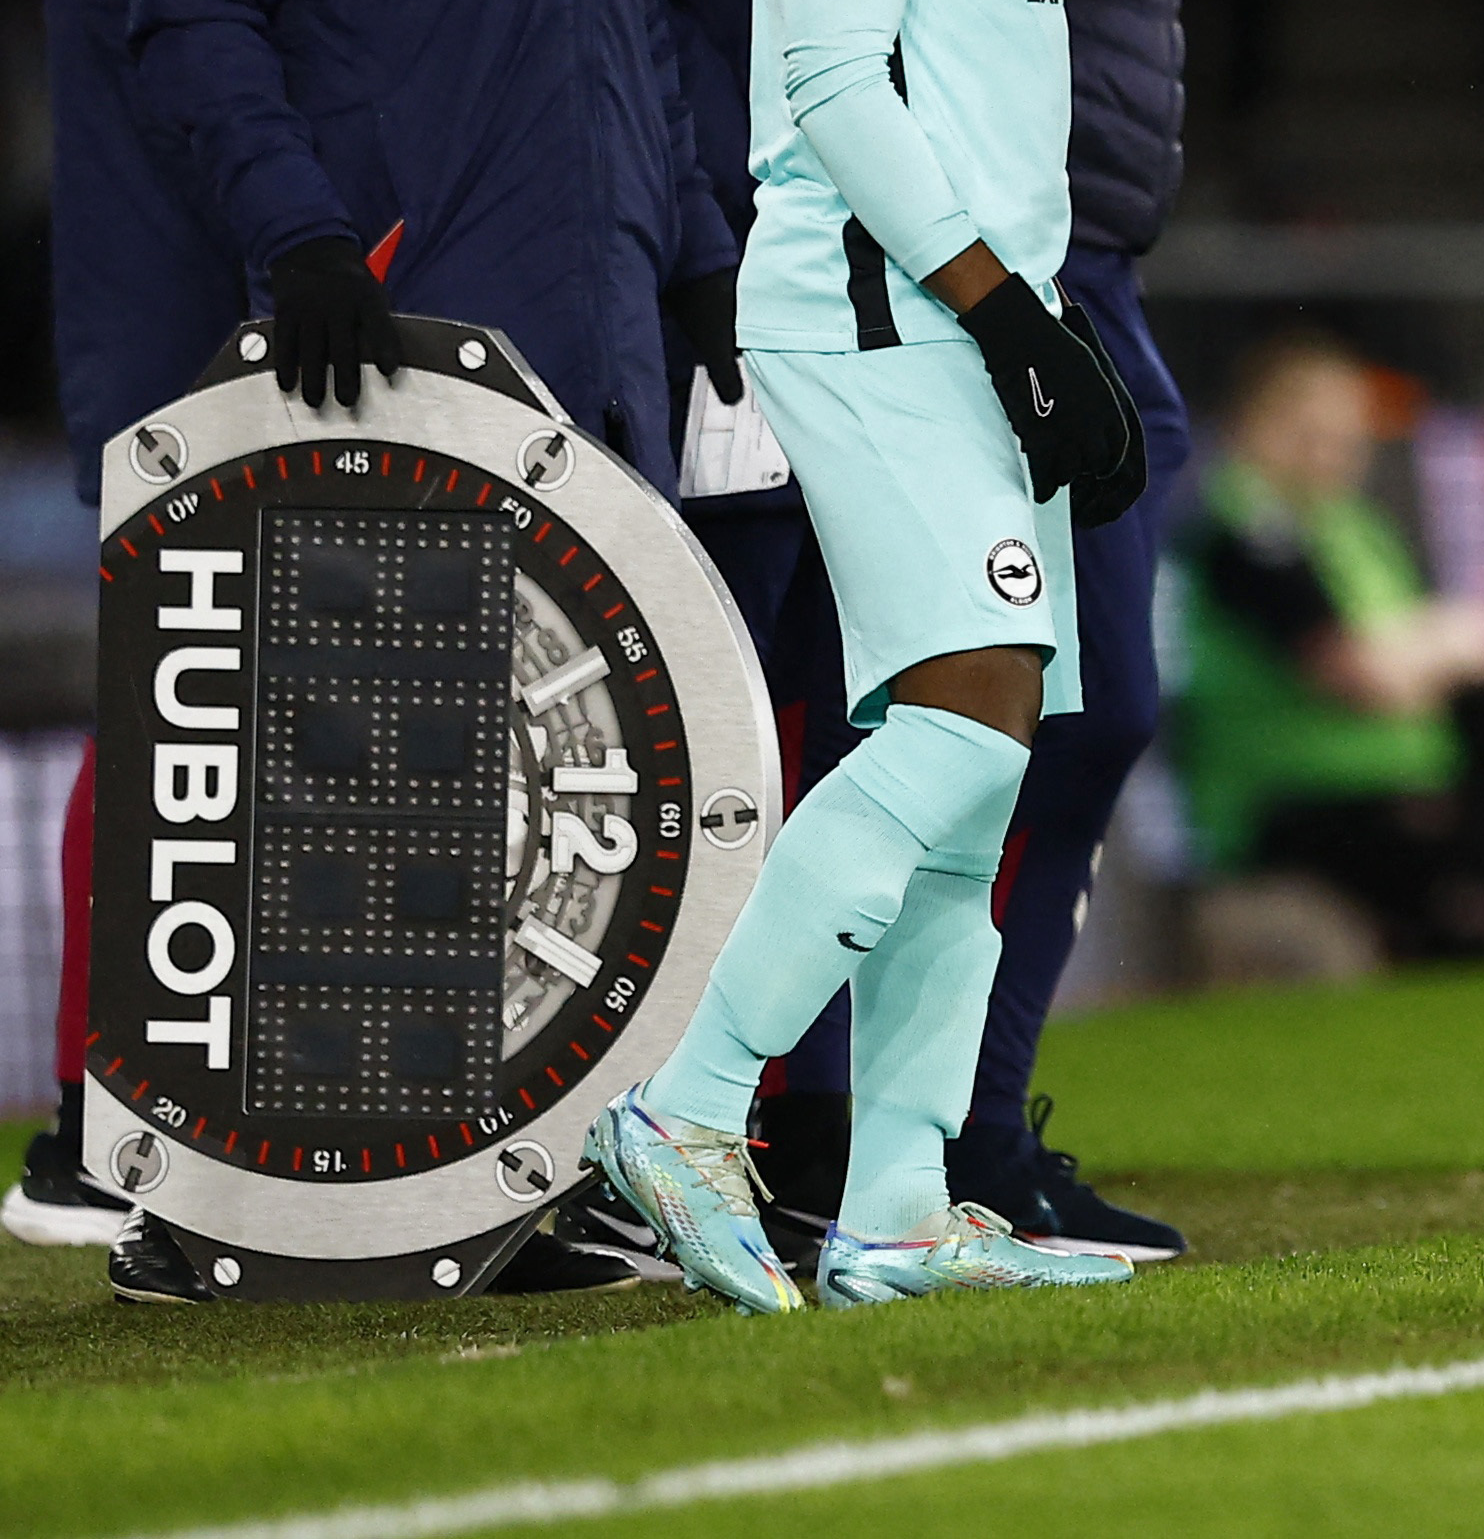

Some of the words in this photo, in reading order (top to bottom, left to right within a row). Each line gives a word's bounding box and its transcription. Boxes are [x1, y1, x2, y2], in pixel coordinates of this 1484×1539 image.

[335, 450, 371, 475] 45
[616, 624, 649, 664] 55
[145, 548, 244, 1070] HUBLOT
[551, 747, 639, 875] 12
[658, 802, 681, 838] 60
[603, 976, 637, 1014] 05
[151, 1095, 188, 1129] 20
[313, 1149, 348, 1174] 15
